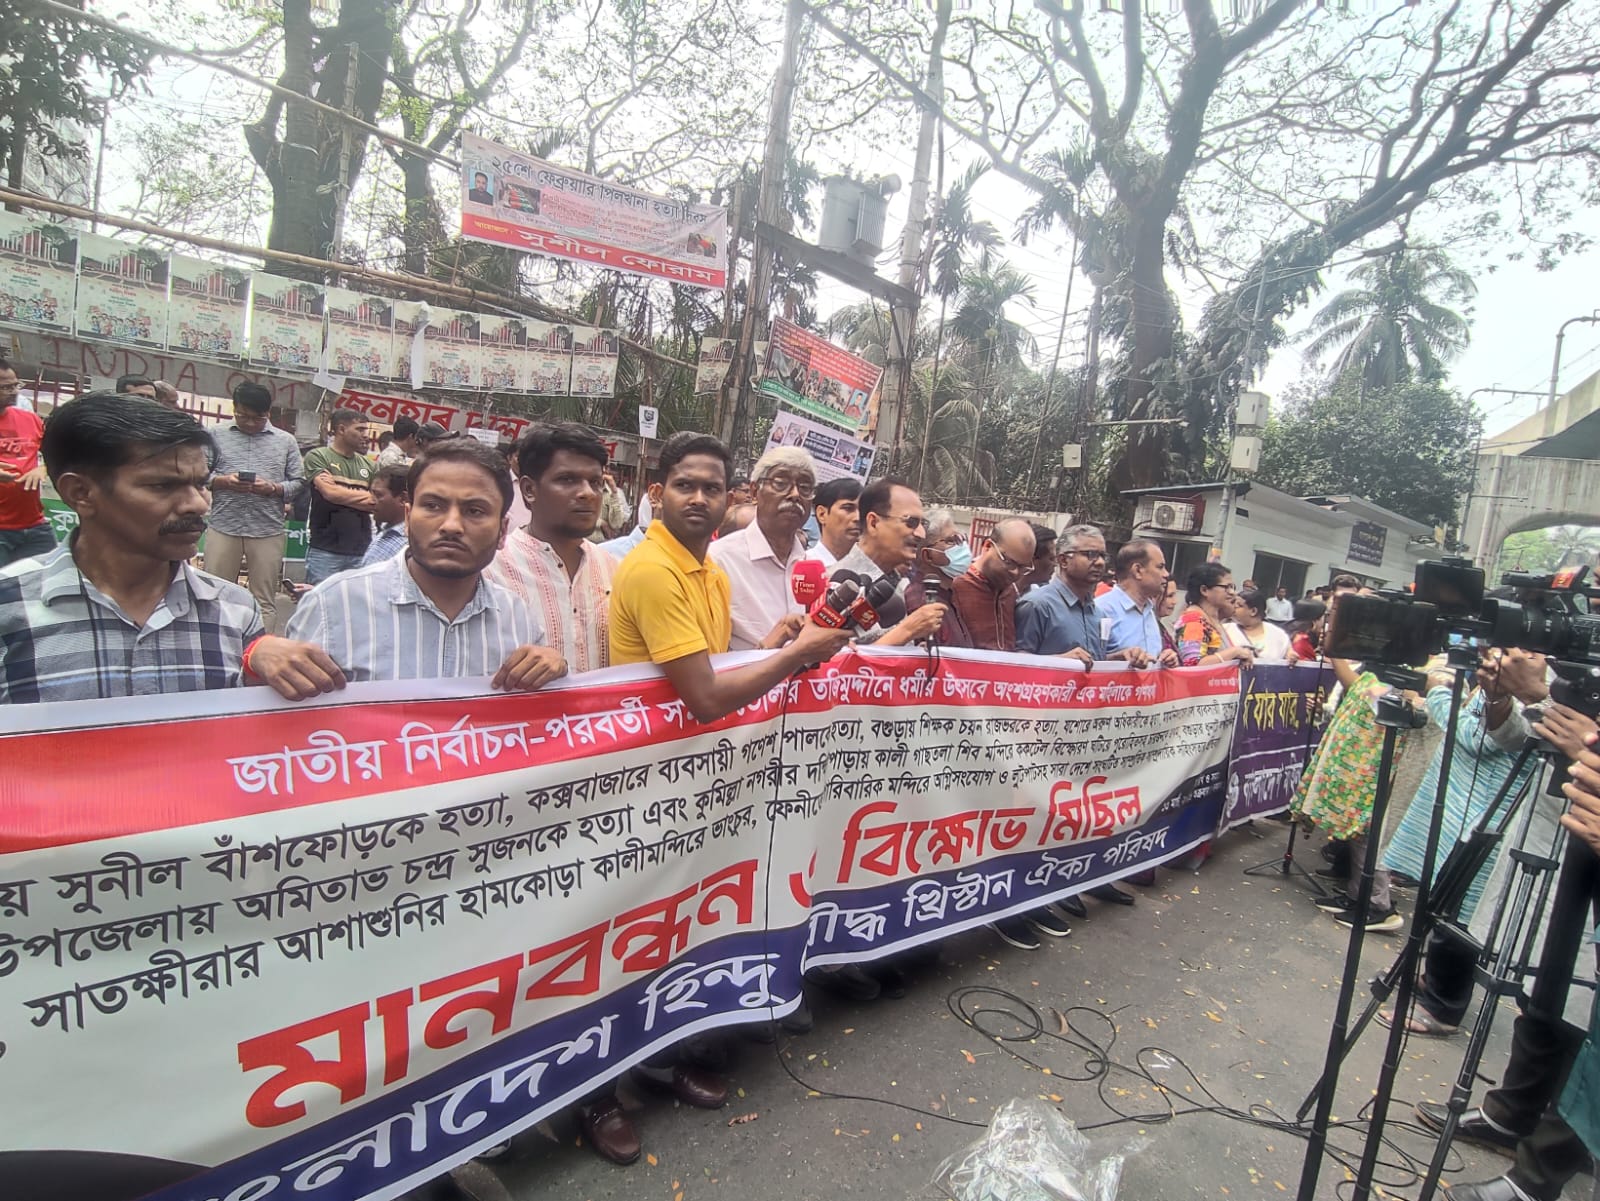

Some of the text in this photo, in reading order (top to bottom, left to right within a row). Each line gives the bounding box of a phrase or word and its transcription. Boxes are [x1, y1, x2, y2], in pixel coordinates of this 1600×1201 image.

[493, 155, 531, 179] ২৫শে
[599, 178, 650, 210] পিলখানা
[652, 199, 679, 221] হত্যা
[39, 341, 199, 391] INDIA
[48, 850, 192, 914] সুনীল
[200, 811, 428, 886] বাঁশফোড়কে
[436, 792, 514, 838] হত্যা,
[525, 761, 654, 815] কক্সবাজারে
[658, 738, 737, 785] ব্যবসায়ী
[741, 729, 779, 764] গণেশ
[830, 718, 864, 744] হত্যা,
[871, 718, 917, 743] বগুড়ায়
[920, 712, 957, 737] শিক্ষক
[225, 729, 388, 795] জাতীয়
[395, 697, 652, 776] নির্বাচন-পরবর্তী
[942, 670, 990, 700] উৎসবে
[1076, 686, 1097, 704] এক
[22, 938, 263, 1033] সাতক্ষীরার
[274, 892, 449, 963] আশাশুনির
[456, 856, 586, 919] হামকোড়া
[592, 826, 706, 882] কালীমন্দিরে
[887, 771, 932, 796] মন্দিরে
[932, 765, 997, 792] অগ্নিসংযোগ
[1000, 770, 1010, 785] ও
[1050, 761, 1071, 779] সারা
[231, 866, 394, 920] অমিতাভ
[401, 848, 459, 886] চন্দ্র
[468, 820, 572, 875] সুজনকে
[577, 804, 634, 844] হত্যা
[643, 795, 690, 827] এবং
[746, 757, 801, 795] নগরীর
[874, 742, 911, 768] কালী
[955, 738, 984, 762] শিব
[985, 738, 1014, 761] মন্দিরে
[236, 858, 760, 1129] মানবন্ধন
[836, 801, 1036, 885] বিক্ষোভ
[1037, 775, 1142, 848] মিছিল
[637, 951, 788, 1032] হিন্দু
[807, 901, 891, 946] ৌদ্ধ
[901, 869, 1016, 928] খ্রিস্টান
[1024, 851, 1097, 887] ঐক্য
[1102, 825, 1171, 867] পরিষদ
